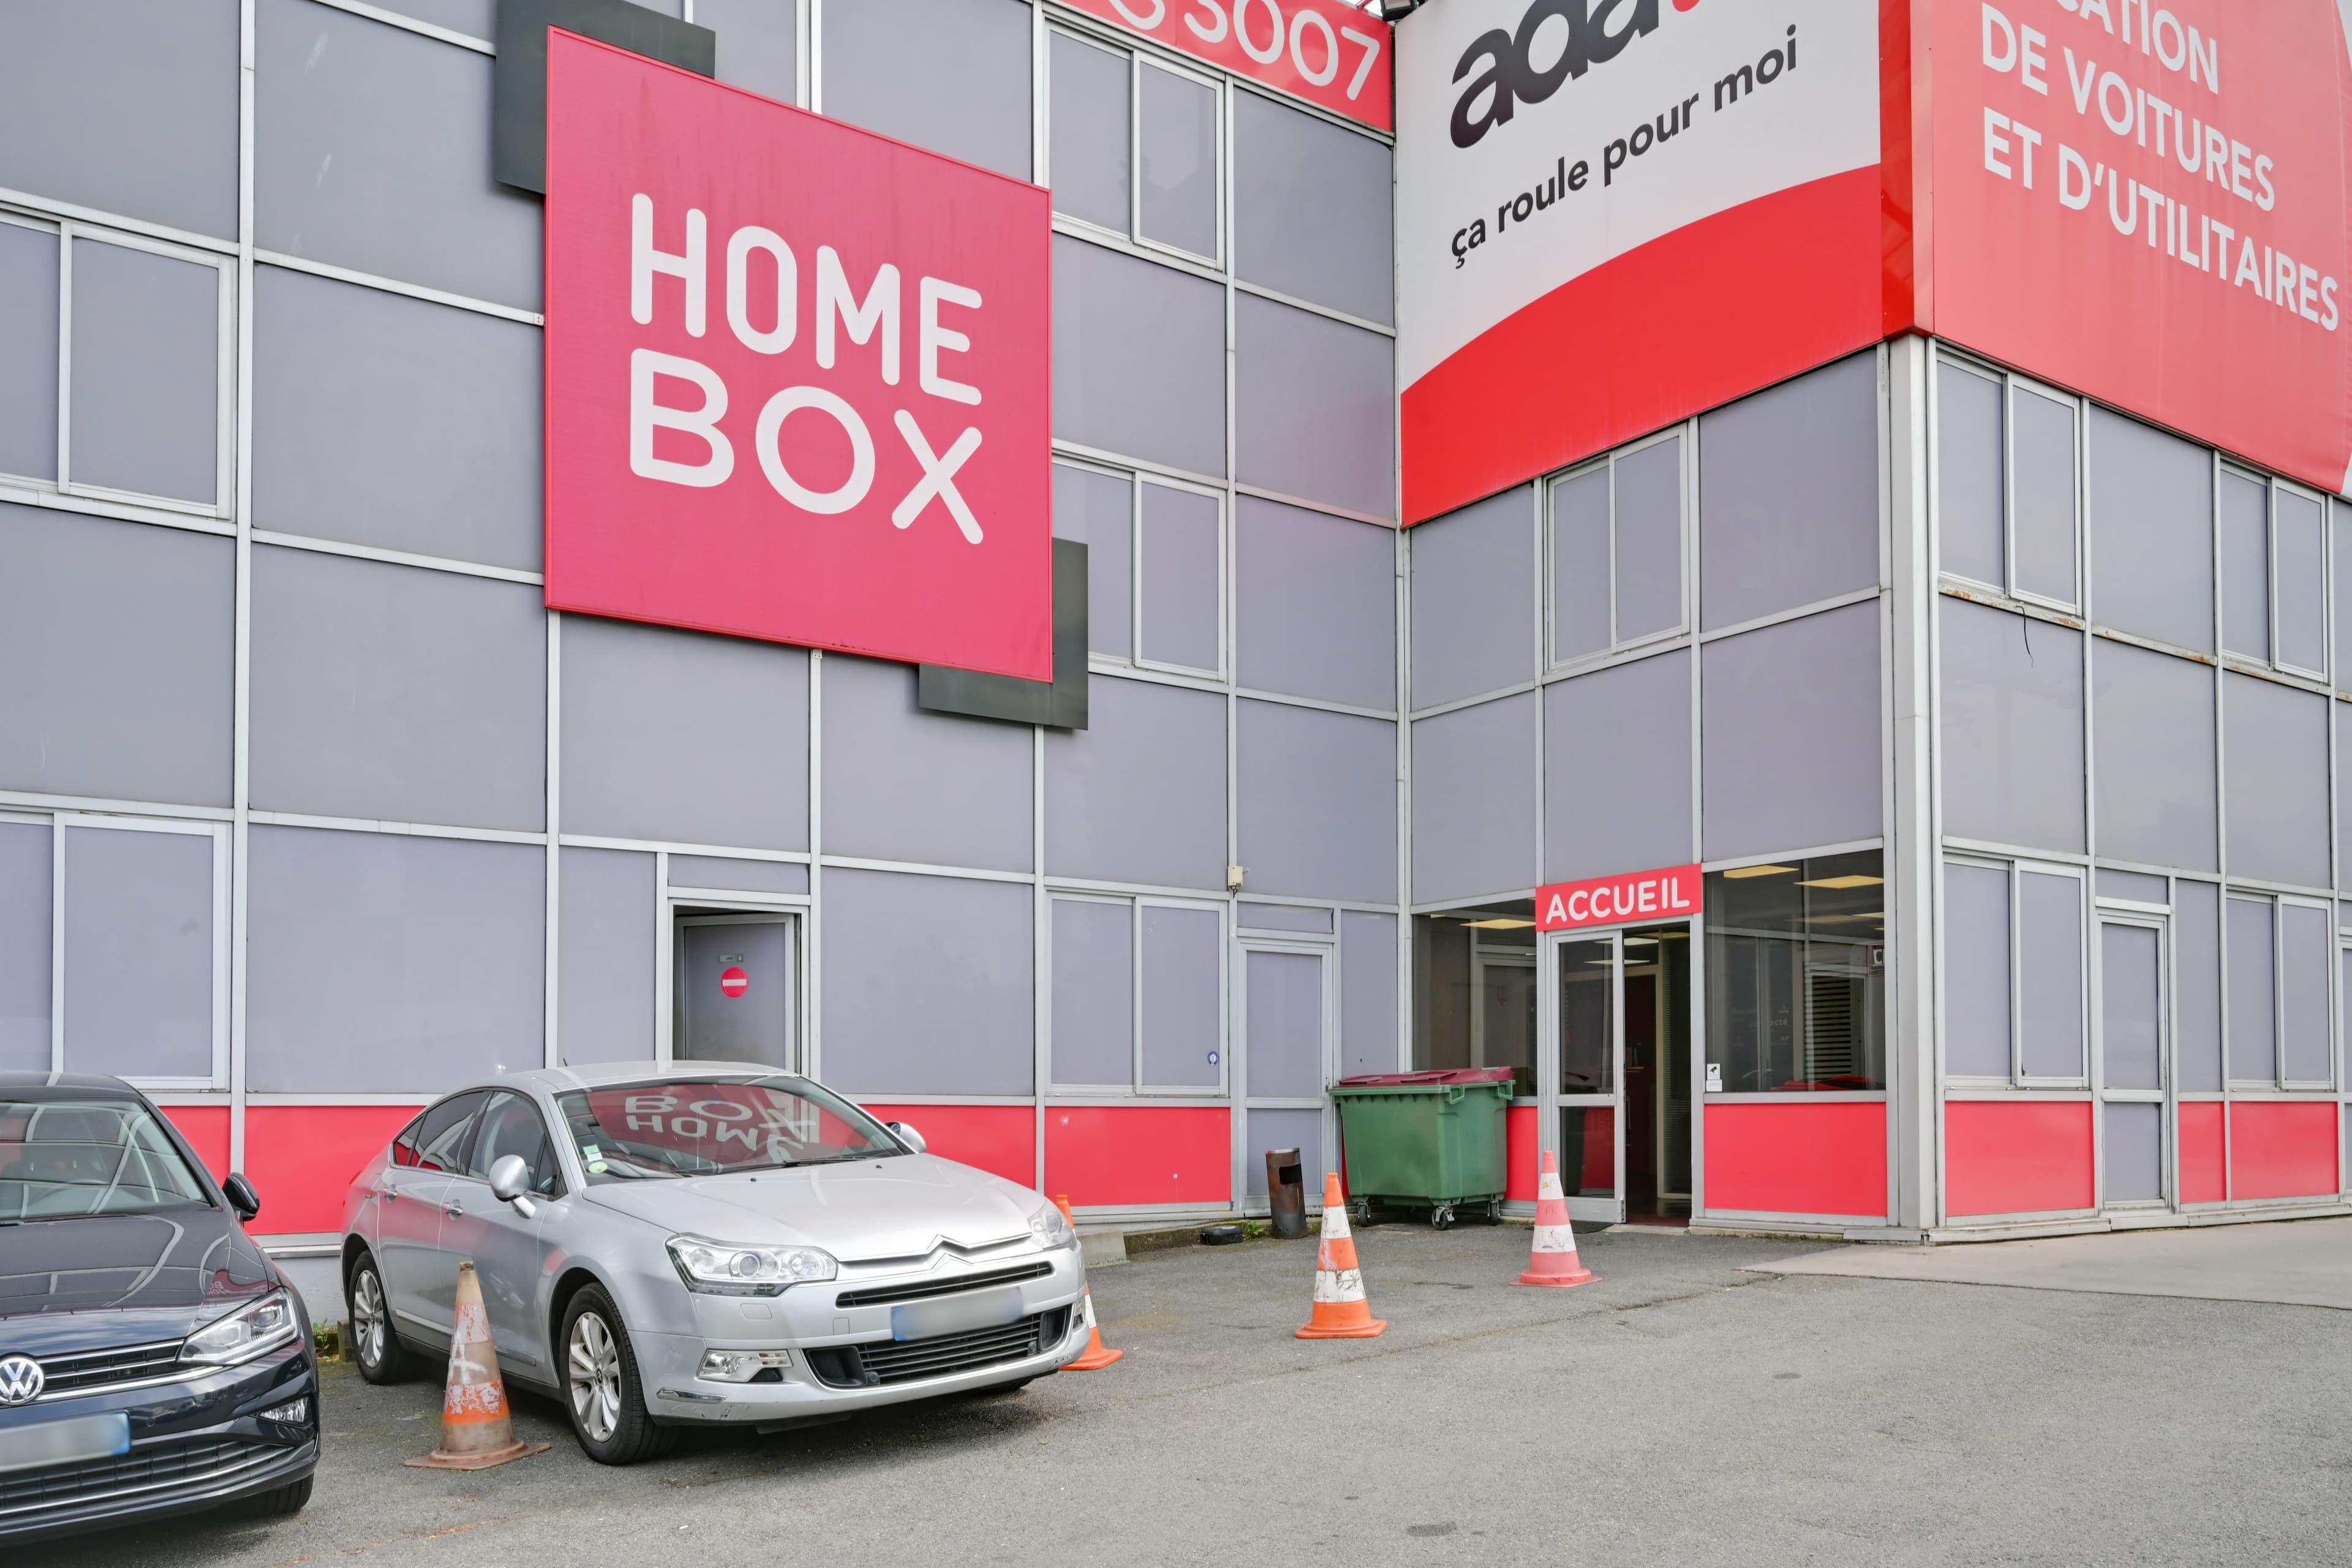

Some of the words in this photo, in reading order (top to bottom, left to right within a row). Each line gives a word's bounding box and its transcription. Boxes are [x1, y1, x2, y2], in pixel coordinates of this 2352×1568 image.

[1451, 219, 1486, 270] ça
[1498, 156, 1588, 233] roule
[1604, 93, 1698, 187] pour
[1714, 24, 1796, 113] moi
[1982, 2, 2048, 96] DE
[2064, 47, 2274, 211] VOITURES
[631, 193, 982, 405] HOME
[1985, 107, 2041, 189] ET
[2059, 143, 2339, 331] D'UTILITAIRES
[630, 348, 983, 544] BOX
[1546, 877, 1689, 924] ACCUEIL
